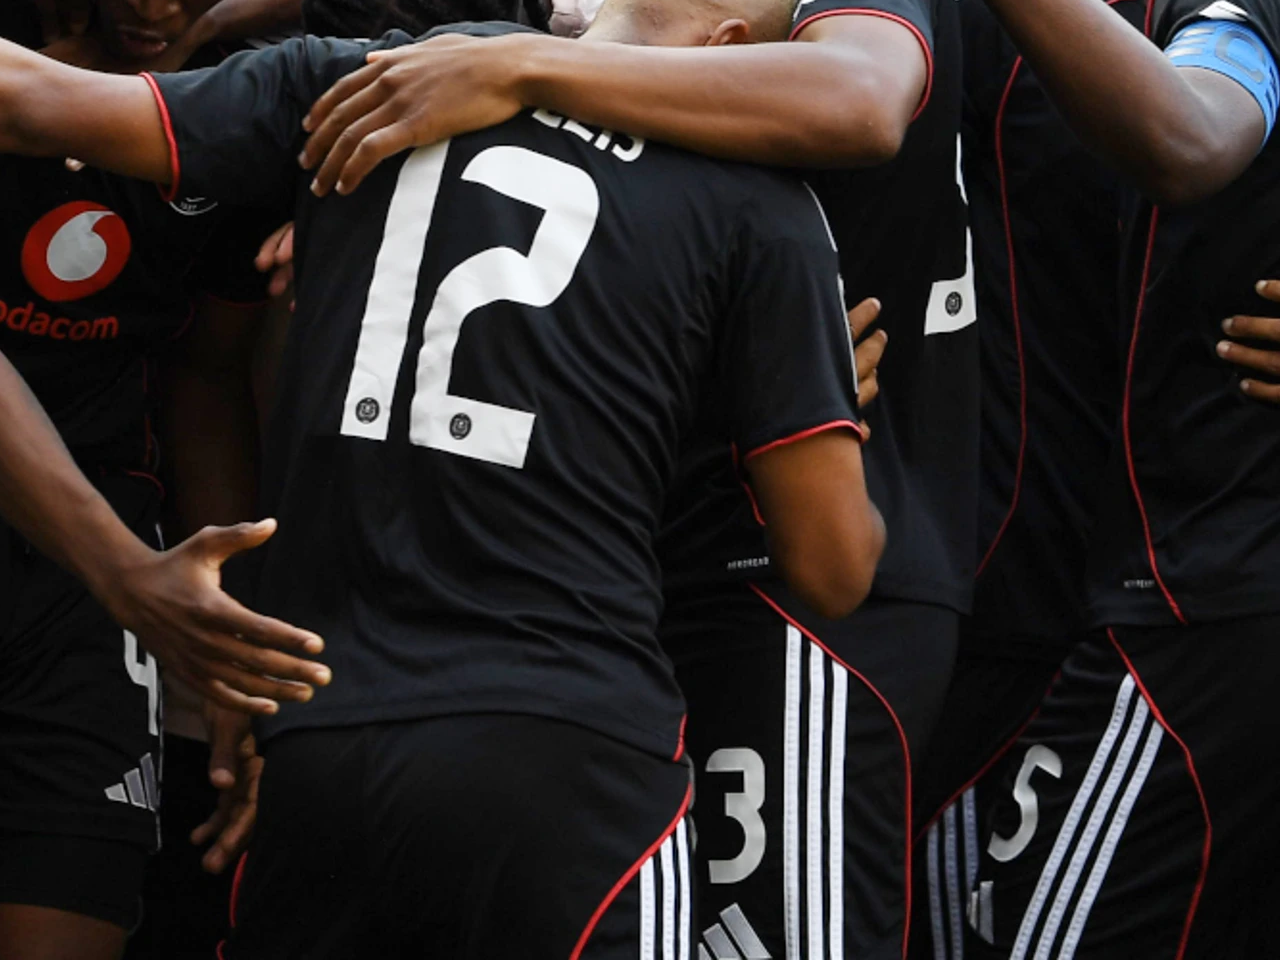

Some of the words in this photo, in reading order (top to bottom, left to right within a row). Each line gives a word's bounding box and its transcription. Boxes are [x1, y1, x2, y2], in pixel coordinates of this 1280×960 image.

[340, 138, 600, 469] 12
[705, 747, 766, 884] 3
[987, 744, 1062, 862] 5
